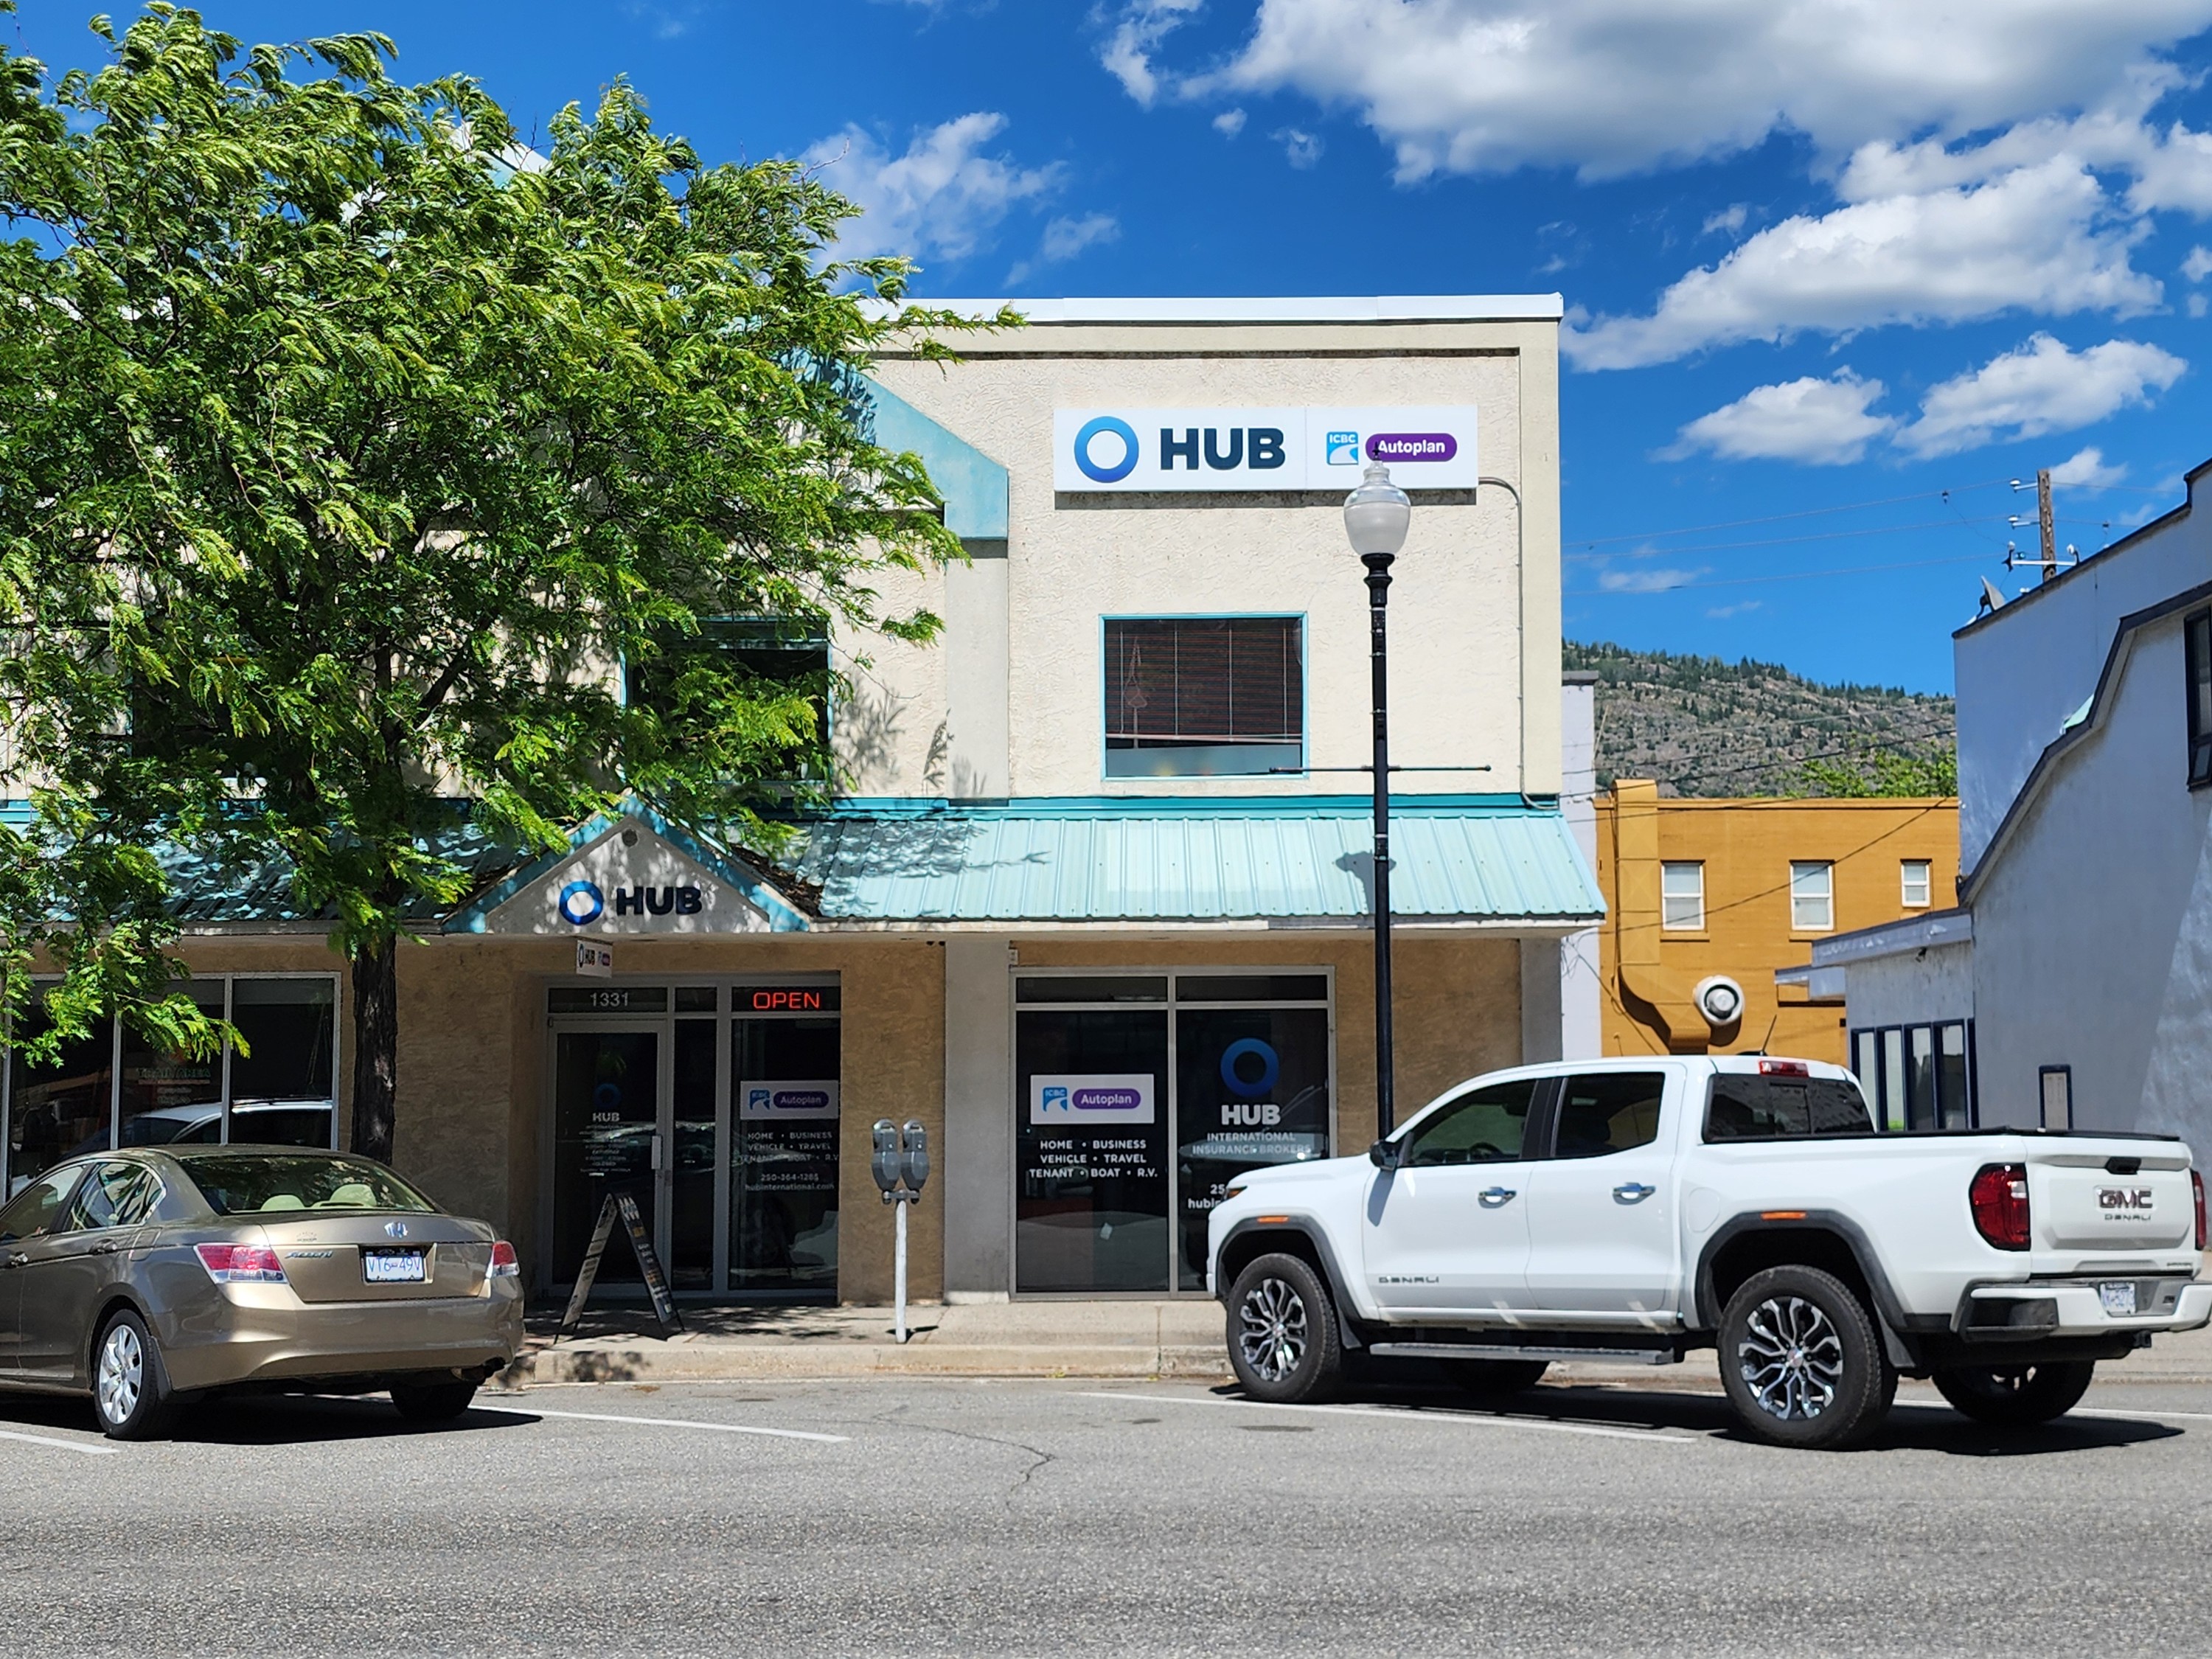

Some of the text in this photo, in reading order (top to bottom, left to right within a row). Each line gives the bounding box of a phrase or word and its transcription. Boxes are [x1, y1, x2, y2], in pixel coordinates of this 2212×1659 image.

[1329, 434, 1356, 444] ICBC
[1160, 427, 1286, 470] HUB
[1377, 439, 1445, 455] Autoplan
[616, 886, 703, 916] HUB
[590, 992, 629, 1007] 1331
[753, 992, 820, 1009] OPEN
[780, 1096, 822, 1105] Autoplan
[1080, 1094, 1133, 1106] Autoplan
[592, 1111, 620, 1122] HUB
[1220, 1105, 1281, 1126] HUB
[747, 1131, 833, 1141] HOME BUSINESS
[1206, 1132, 1296, 1142] INTERNATIONAL
[1040, 1139, 1147, 1150] HOME BUSINESS
[1192, 1144, 1312, 1155] INSURANCE BROKERS
[1040, 1153, 1147, 1164] VEHICLE TRAVEL
[1030, 1167, 1158, 1178] TENANT BOAT R.V.
[2099, 1189, 2153, 1209] GMC
[1378, 1276, 1439, 1284] DENALI
